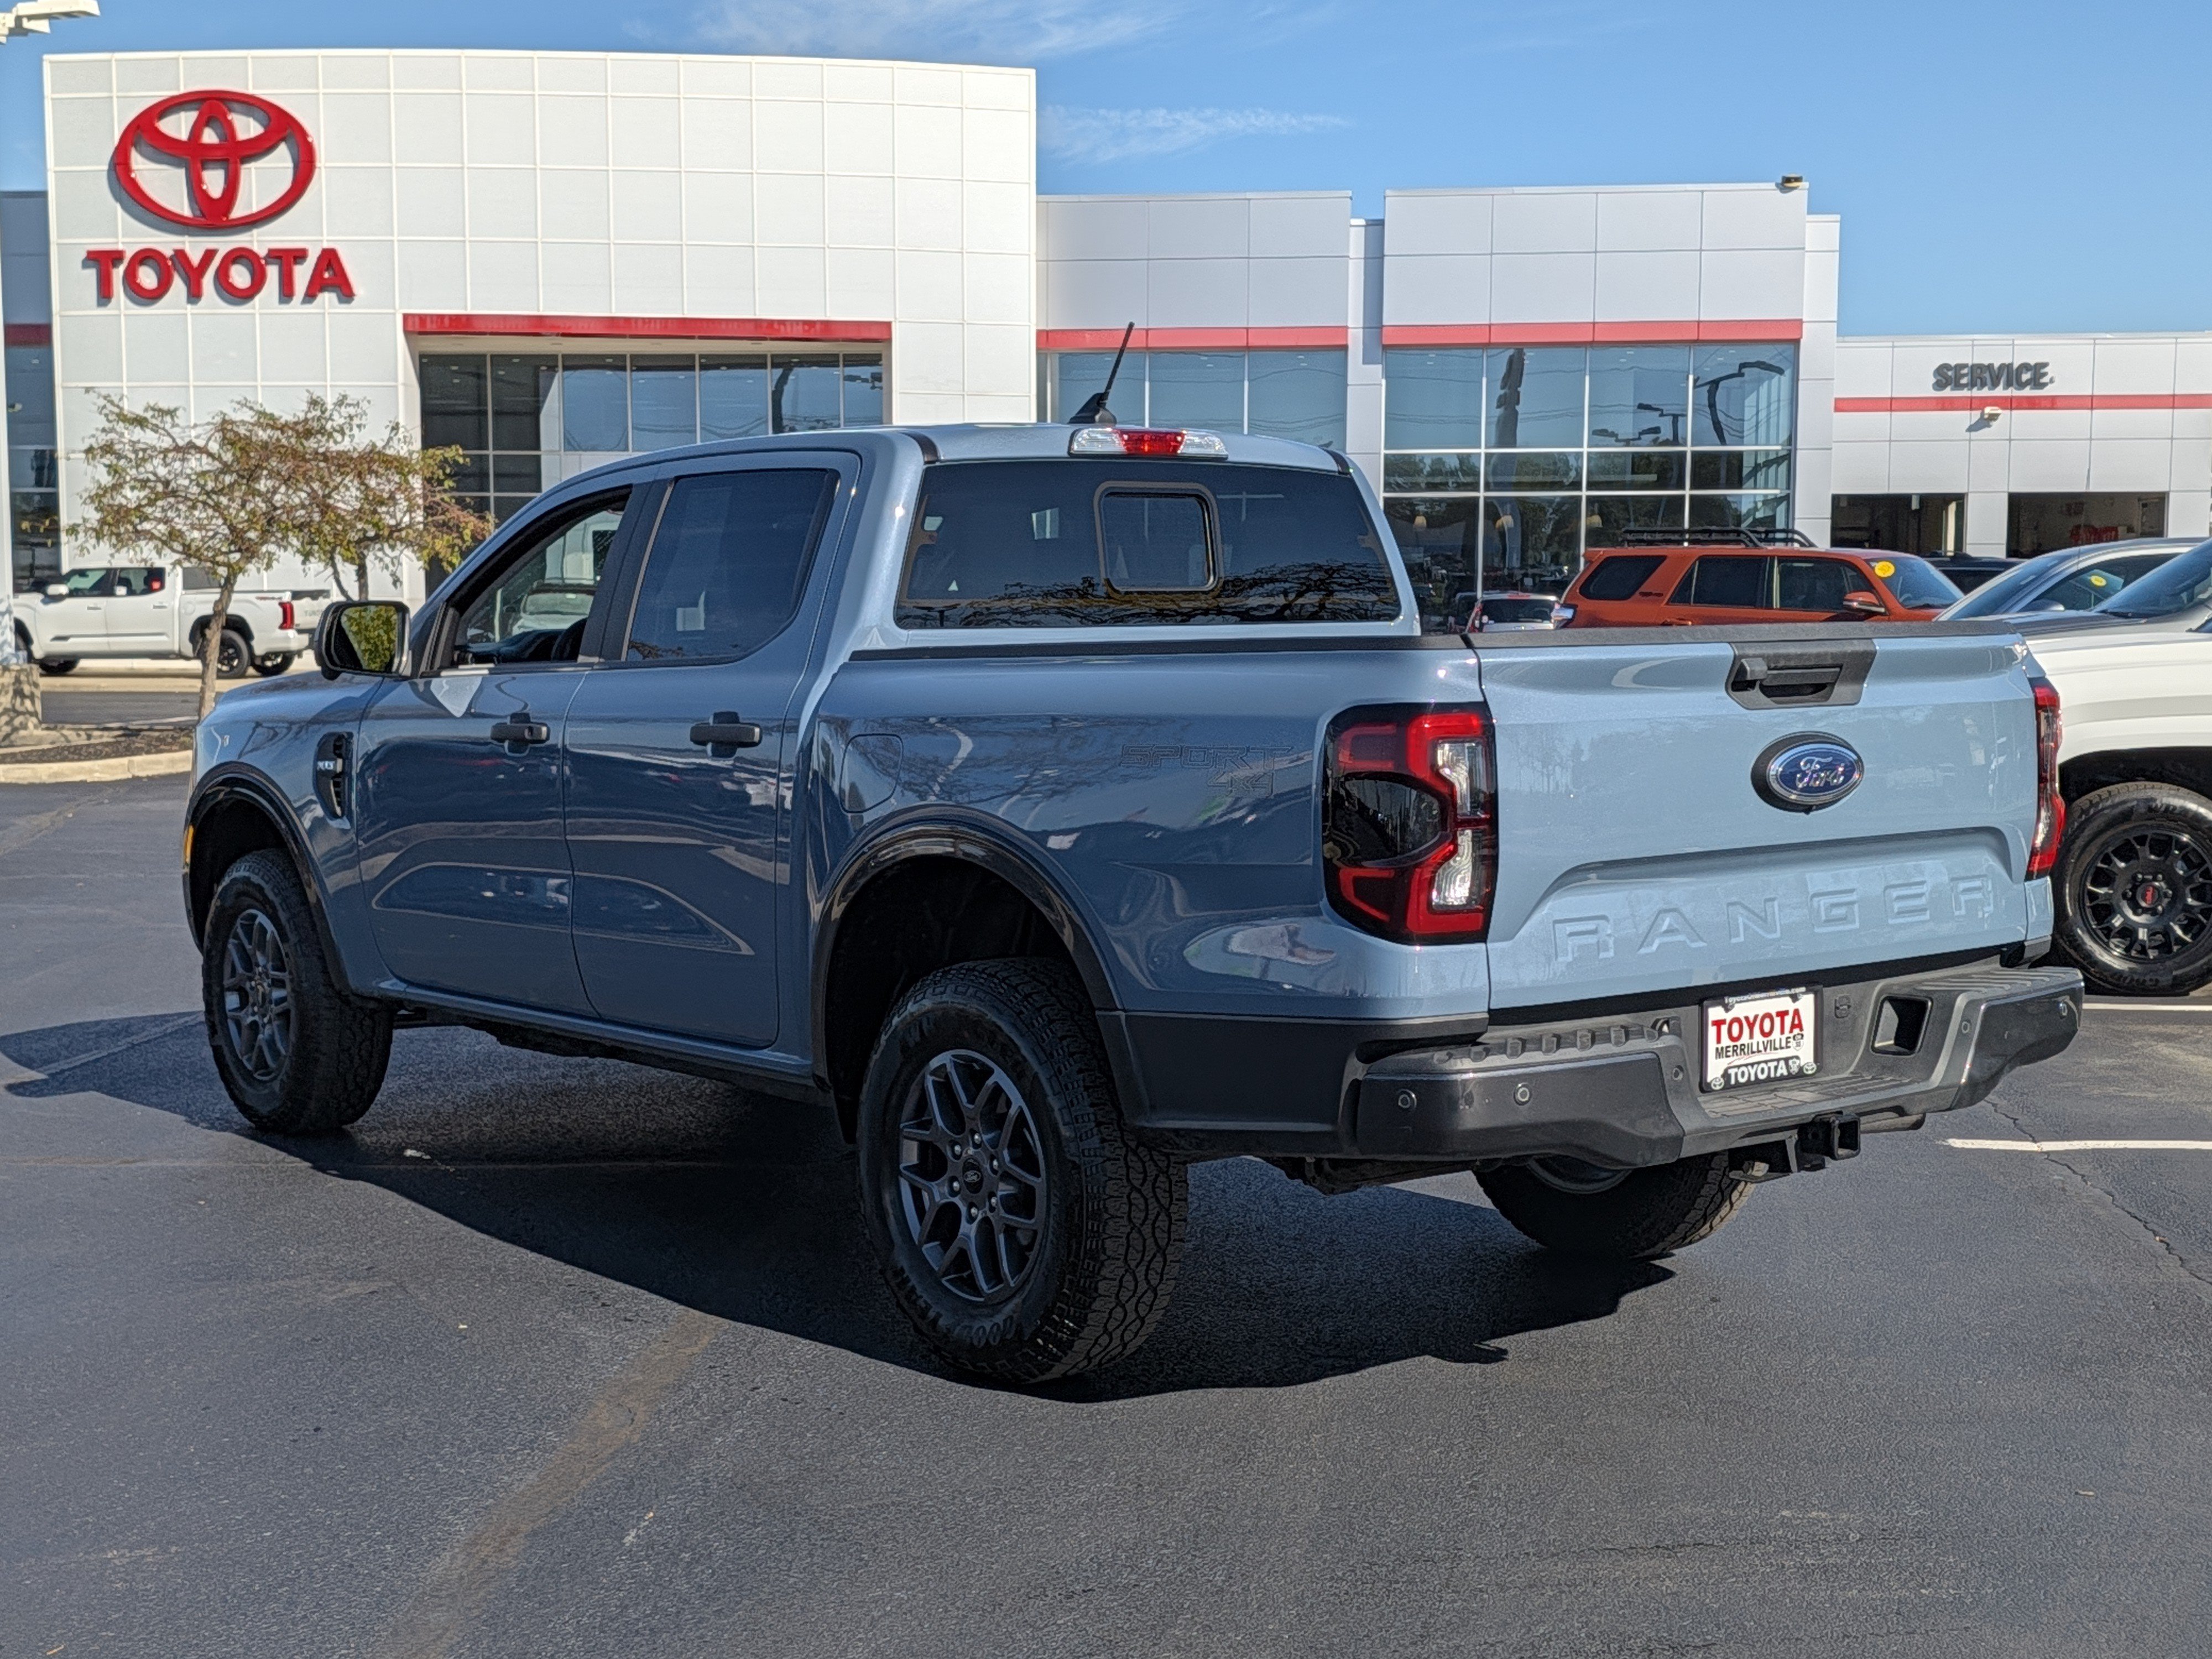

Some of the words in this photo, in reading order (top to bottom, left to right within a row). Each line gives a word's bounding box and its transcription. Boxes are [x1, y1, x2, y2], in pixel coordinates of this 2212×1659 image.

[87, 247, 355, 299] TOYOTA
[1933, 362, 2049, 390] SERVICE
[1119, 744, 1292, 770] SPORT
[1796, 756, 1845, 788] Ford
[1552, 873, 1992, 962] RANGER
[1711, 1008, 1804, 1045] TOYOTA
[1715, 1036, 1792, 1060] MERRILLVILLE
[1728, 1060, 1788, 1085] TOYOTA
